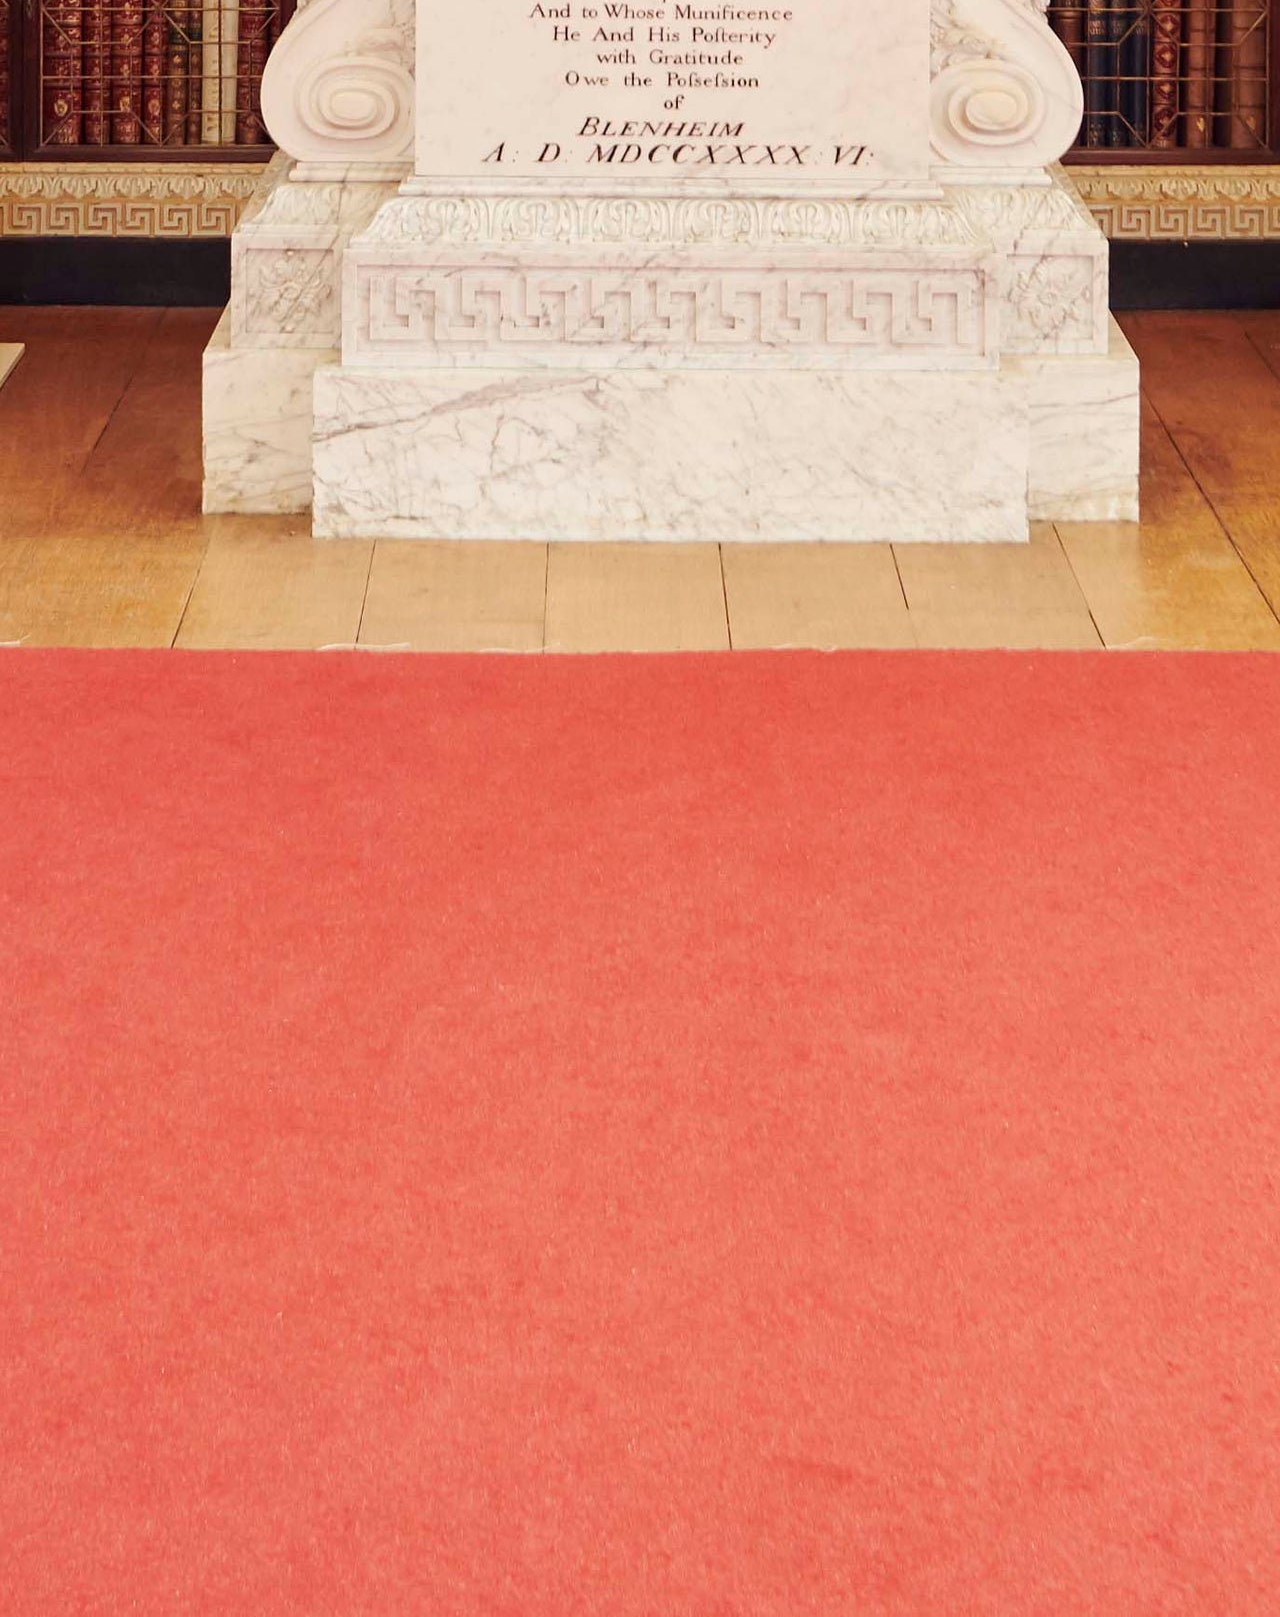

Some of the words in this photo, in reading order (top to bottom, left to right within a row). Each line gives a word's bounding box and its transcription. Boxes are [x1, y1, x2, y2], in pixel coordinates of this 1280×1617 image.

[528, 2, 571, 19] And
[581, 6, 599, 20] to
[603, 2, 666, 20] Whose
[674, 3, 793, 21] Munificence
[552, 24, 581, 42] He
[591, 25, 635, 43] And
[647, 26, 680, 43] His
[596, 48, 637, 65] with
[648, 48, 744, 66] Gratitude
[564, 69, 609, 87] Owe
[623, 71, 653, 88] the
[663, 93, 686, 111] of
[575, 115, 746, 139] BLENHEIM
